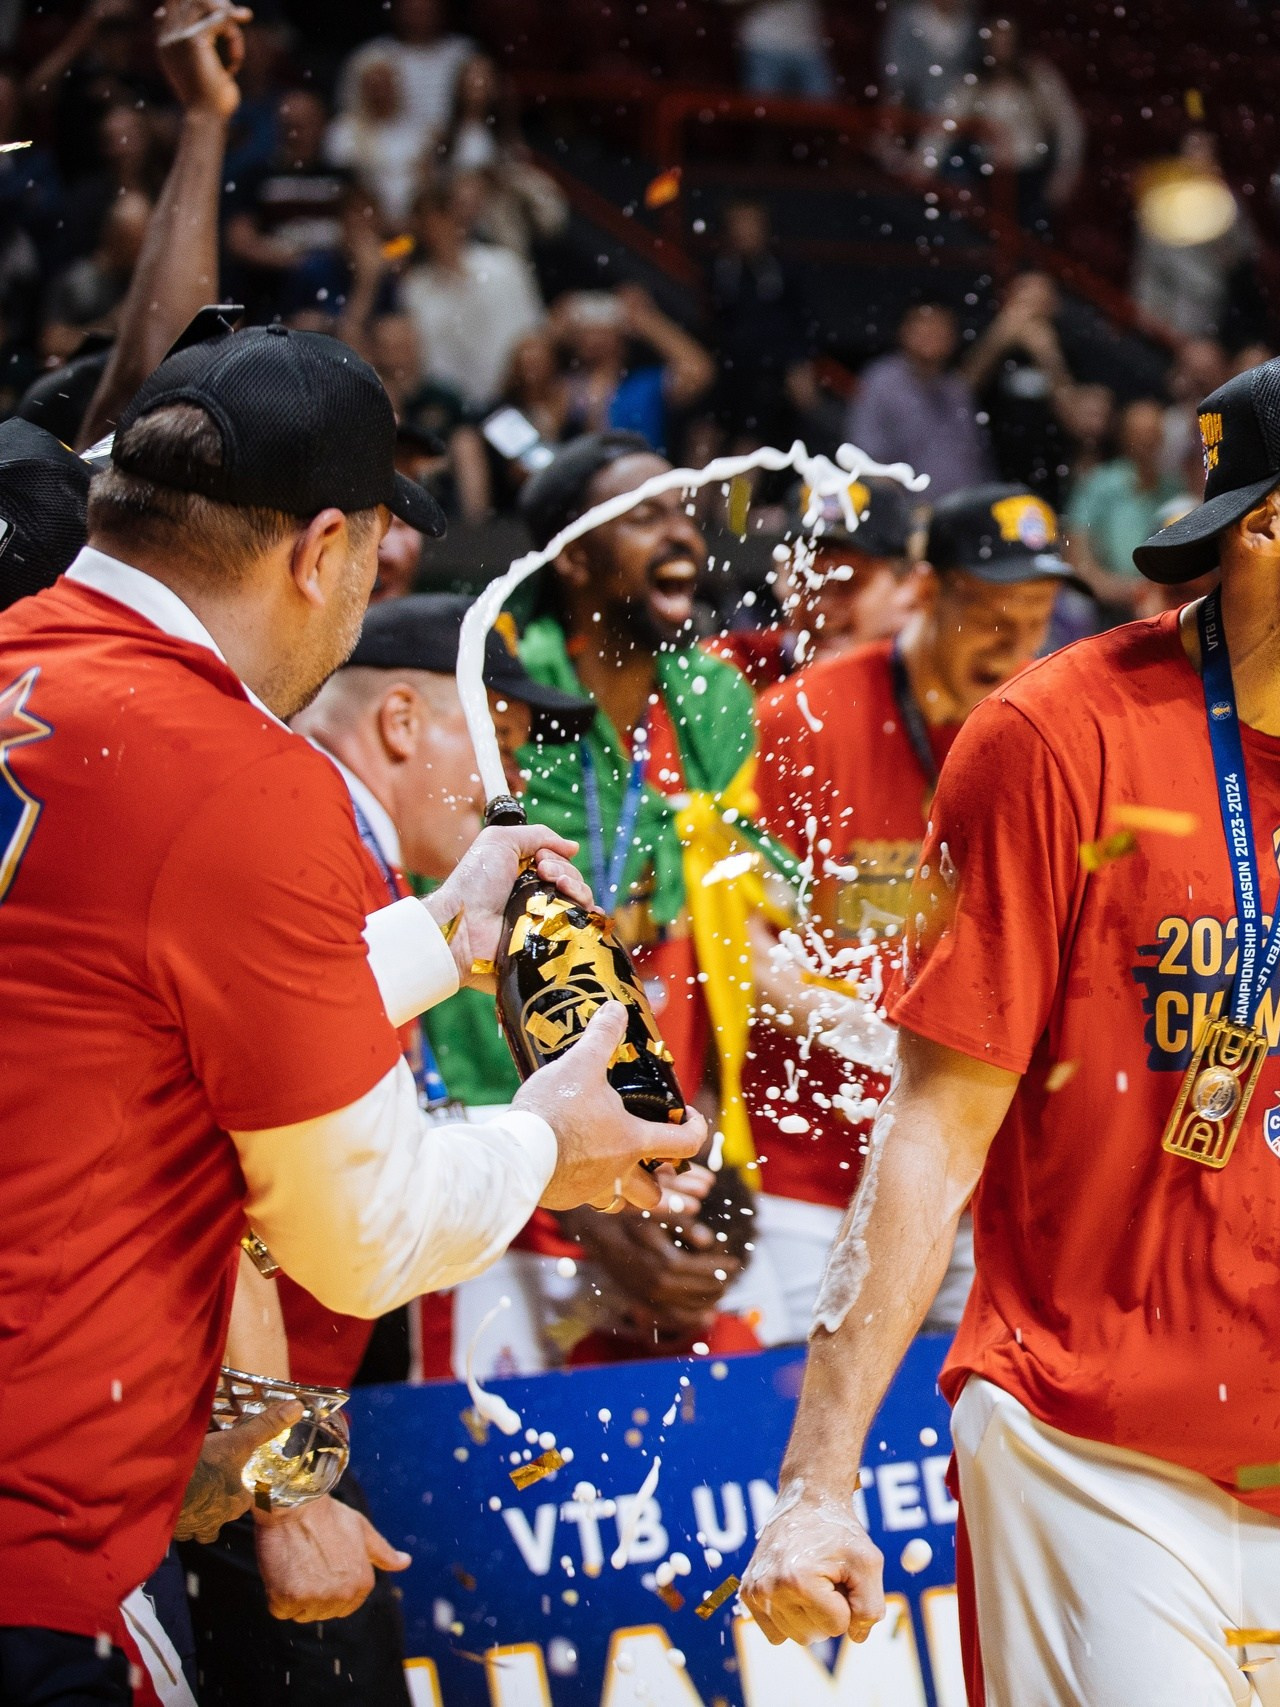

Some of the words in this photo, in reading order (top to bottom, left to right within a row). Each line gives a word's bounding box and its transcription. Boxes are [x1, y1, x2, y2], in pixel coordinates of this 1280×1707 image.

[1205, 622, 1219, 651] VTB
[1224, 772, 1249, 857] 2023-2024
[1237, 861, 1256, 919] SEASON
[1157, 917, 1274, 976] 202
[1234, 923, 1257, 1027] HAMPIONSHIP
[502, 1495, 668, 1577] VTB
